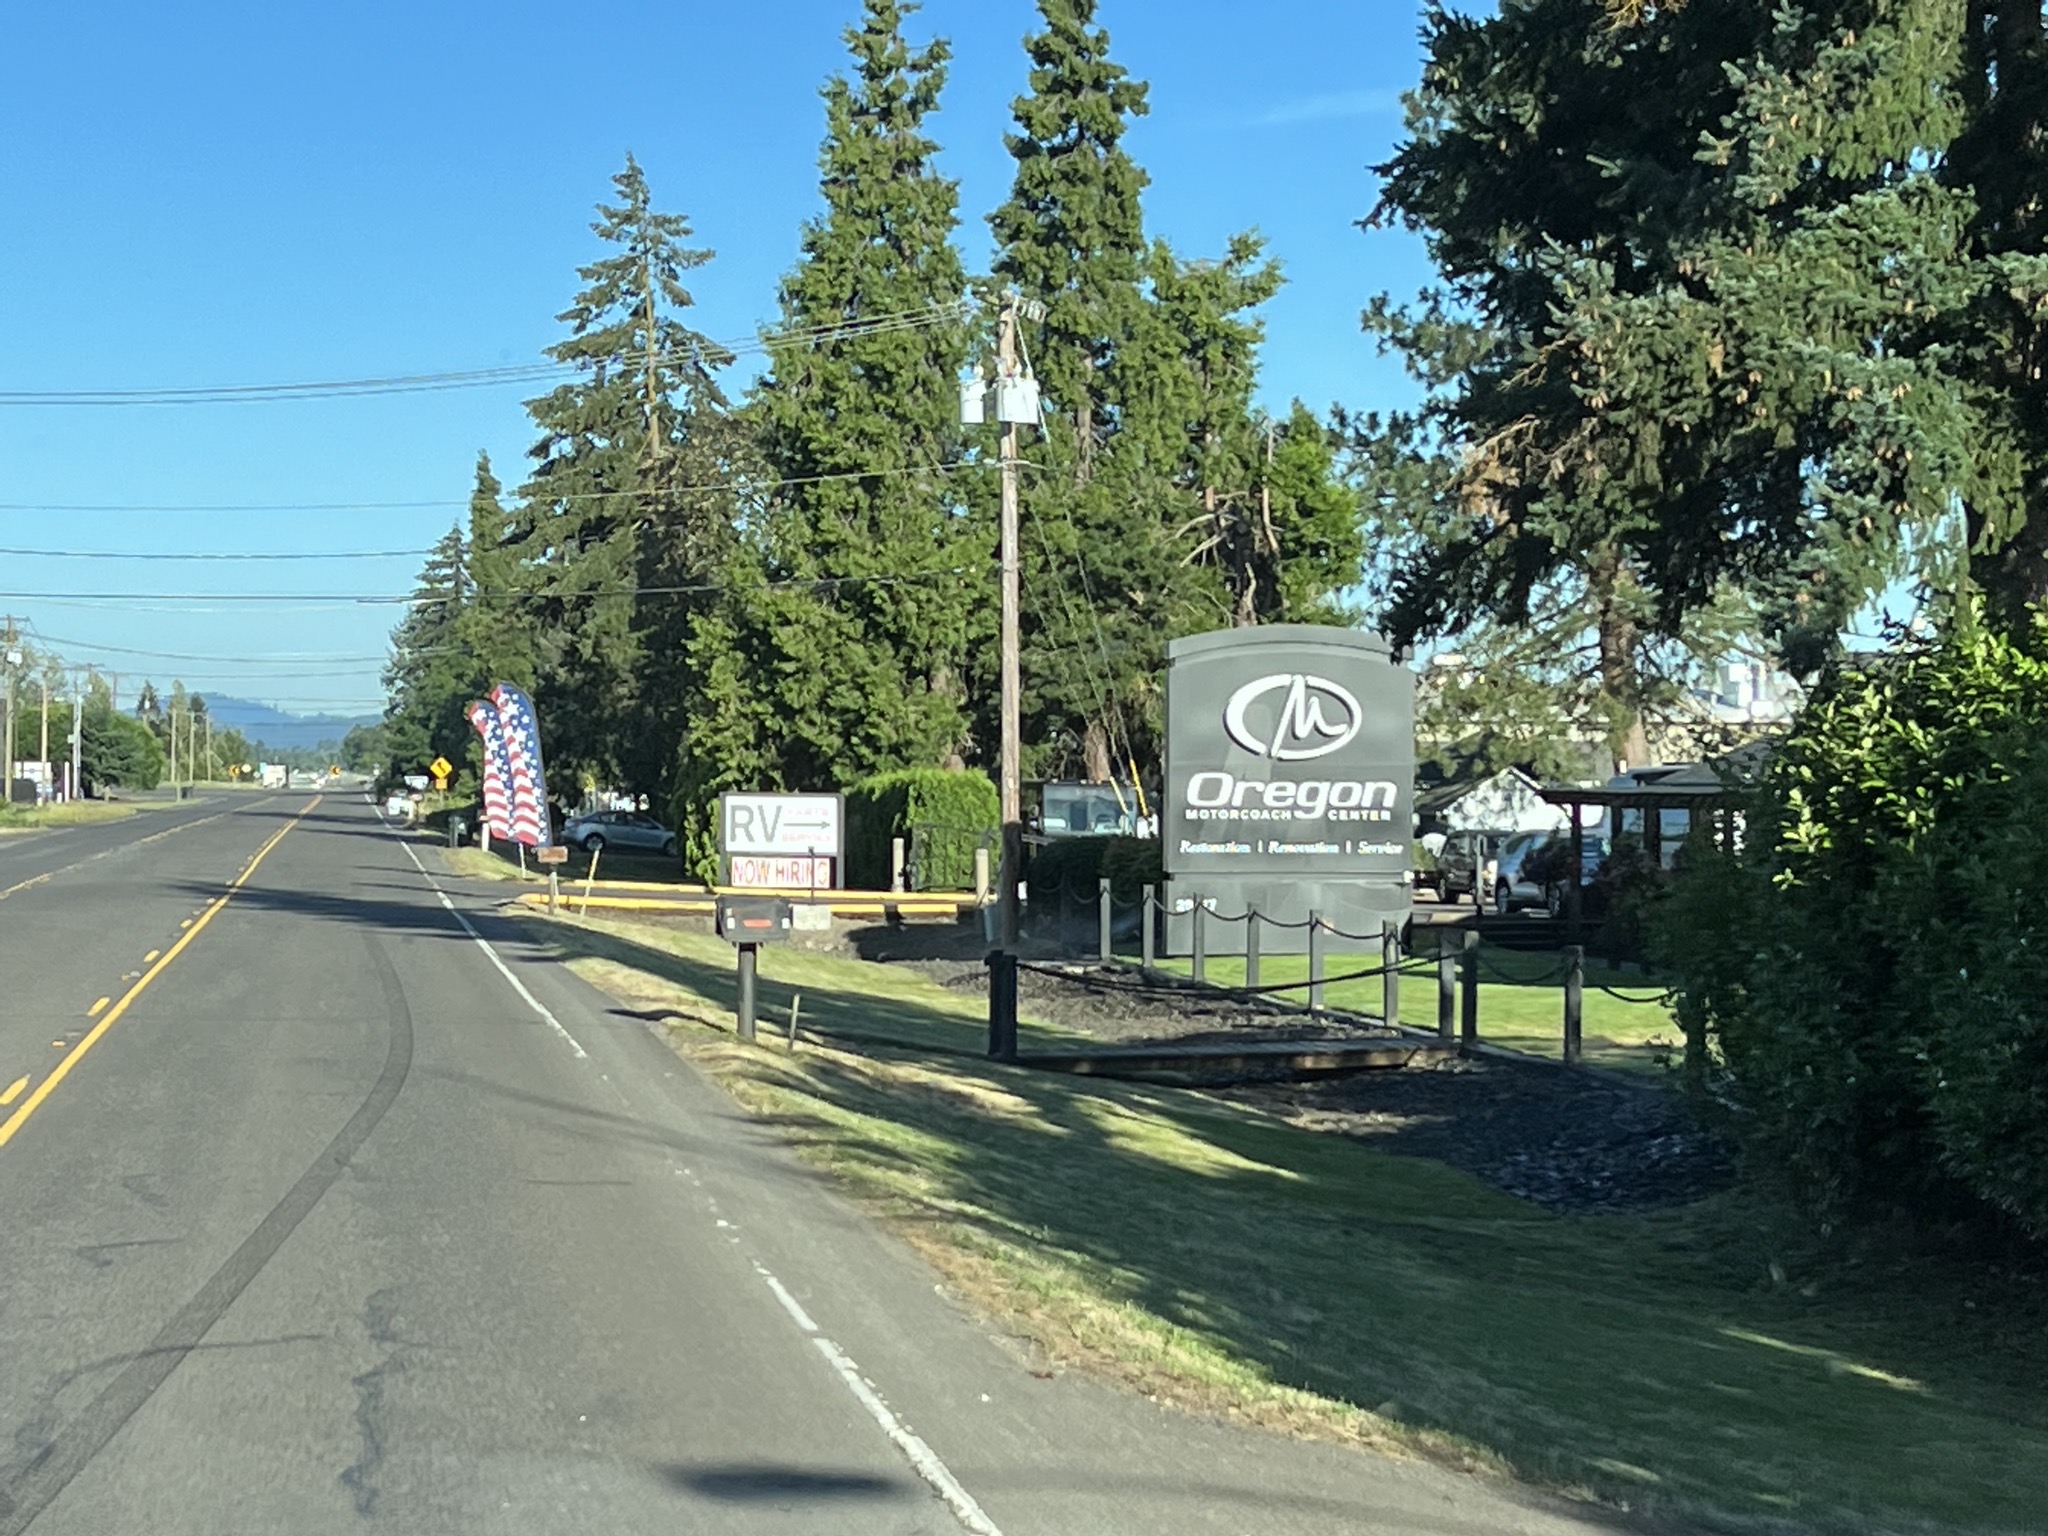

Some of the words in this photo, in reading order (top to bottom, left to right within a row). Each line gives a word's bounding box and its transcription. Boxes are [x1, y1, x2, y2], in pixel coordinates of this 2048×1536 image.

[1186, 772, 1398, 820] Oregon
[730, 804, 783, 843] RV
[1185, 809, 1292, 821] MOTORCOACH
[1327, 809, 1392, 821] CENTER
[1179, 840, 1252, 854] Restoration
[1268, 840, 1340, 855] Renovation
[1357, 840, 1405, 855] Service
[733, 860, 770, 885] NOW
[775, 860, 828, 886] HIRING
